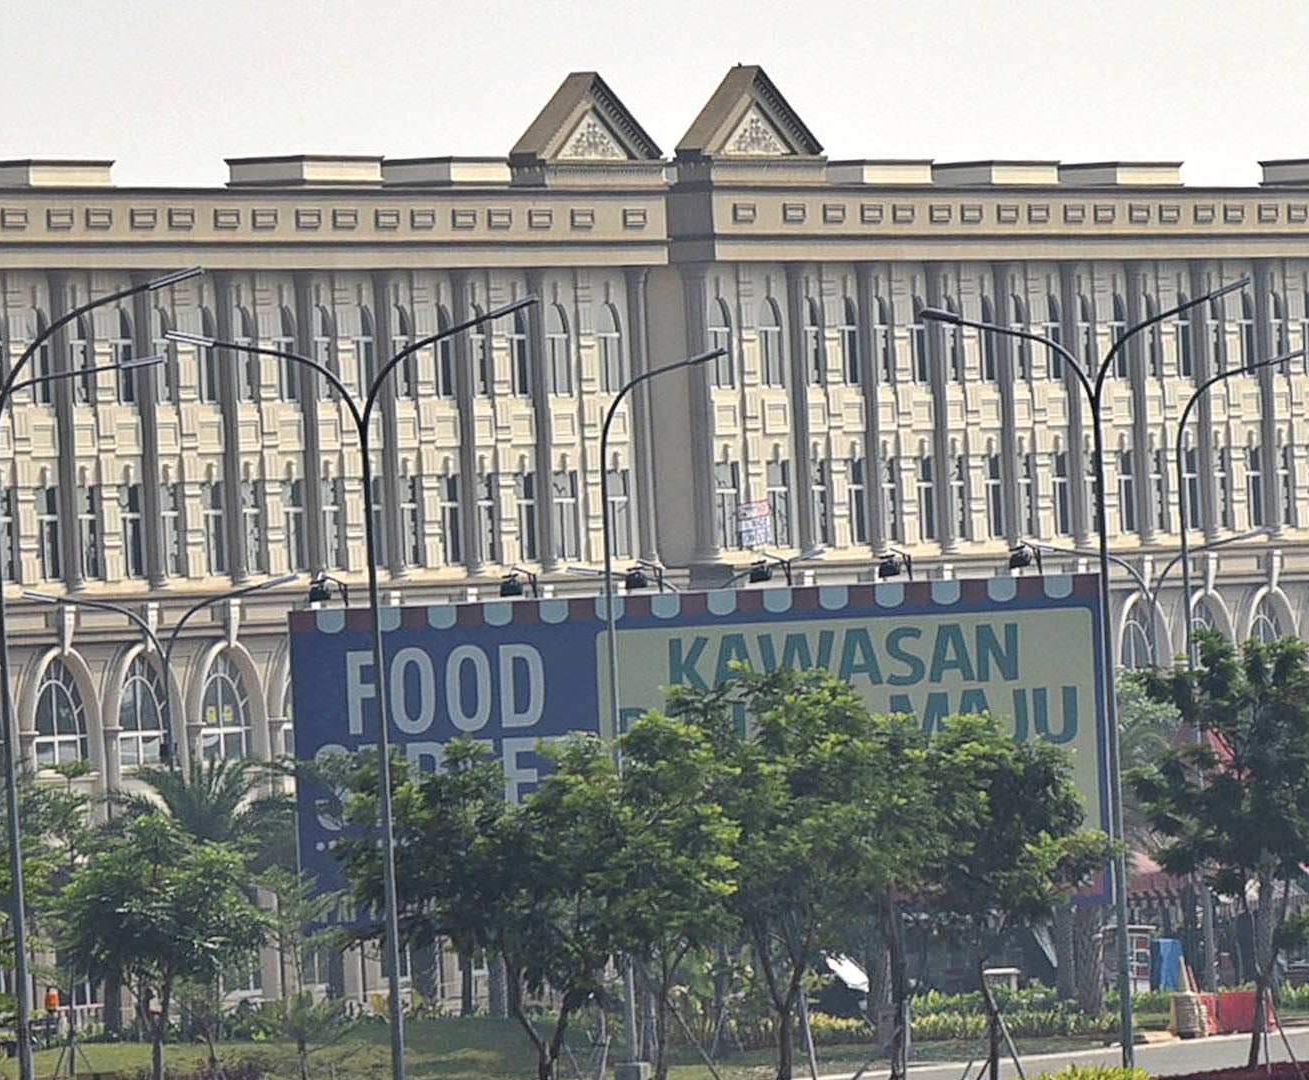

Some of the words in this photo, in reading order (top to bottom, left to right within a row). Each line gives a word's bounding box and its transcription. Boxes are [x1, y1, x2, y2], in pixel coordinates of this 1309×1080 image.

[345, 643, 545, 735] FOOD
[668, 622, 1019, 690] KAWASAN
[889, 685, 1078, 745] MAJU
